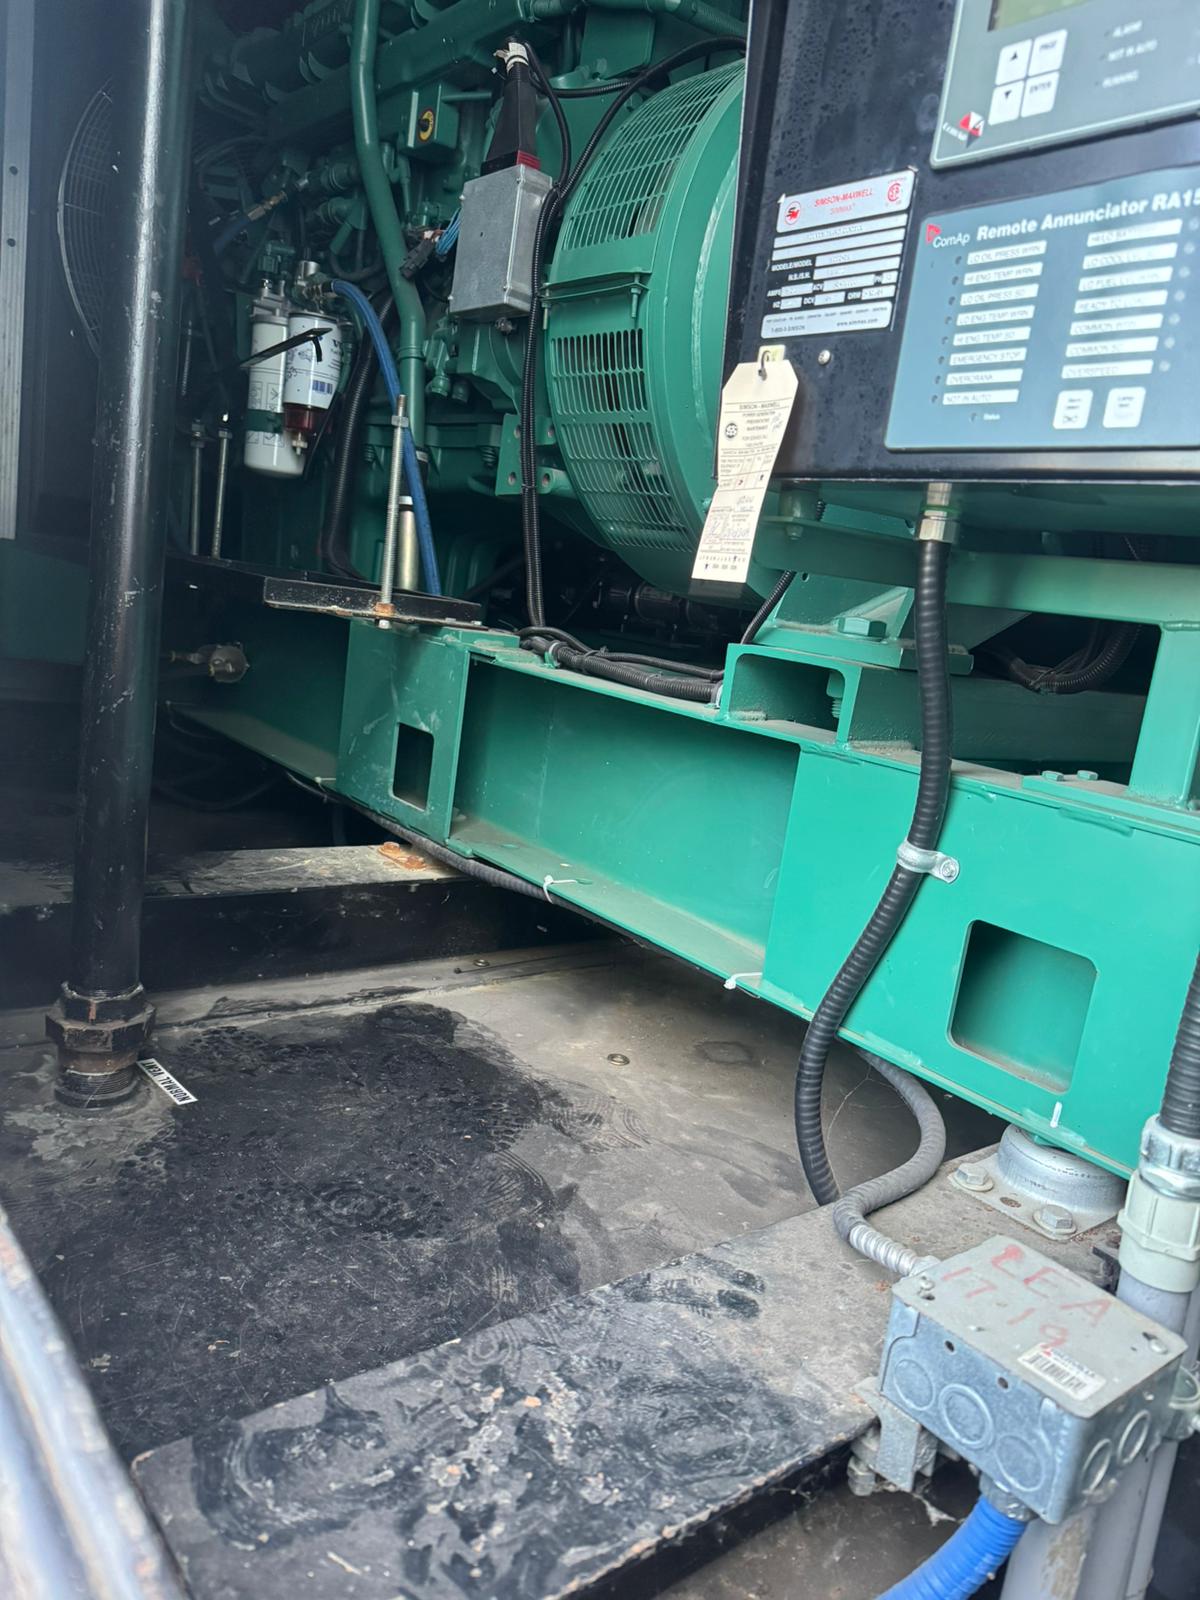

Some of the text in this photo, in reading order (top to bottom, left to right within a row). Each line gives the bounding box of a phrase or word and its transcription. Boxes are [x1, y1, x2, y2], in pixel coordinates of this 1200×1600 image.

[933, 232, 970, 248] ComAp
[976, 218, 1037, 241] Remote
[1041, 199, 1148, 231] Annunciator
[142, 1061, 192, 1101] NORMAL VENT
